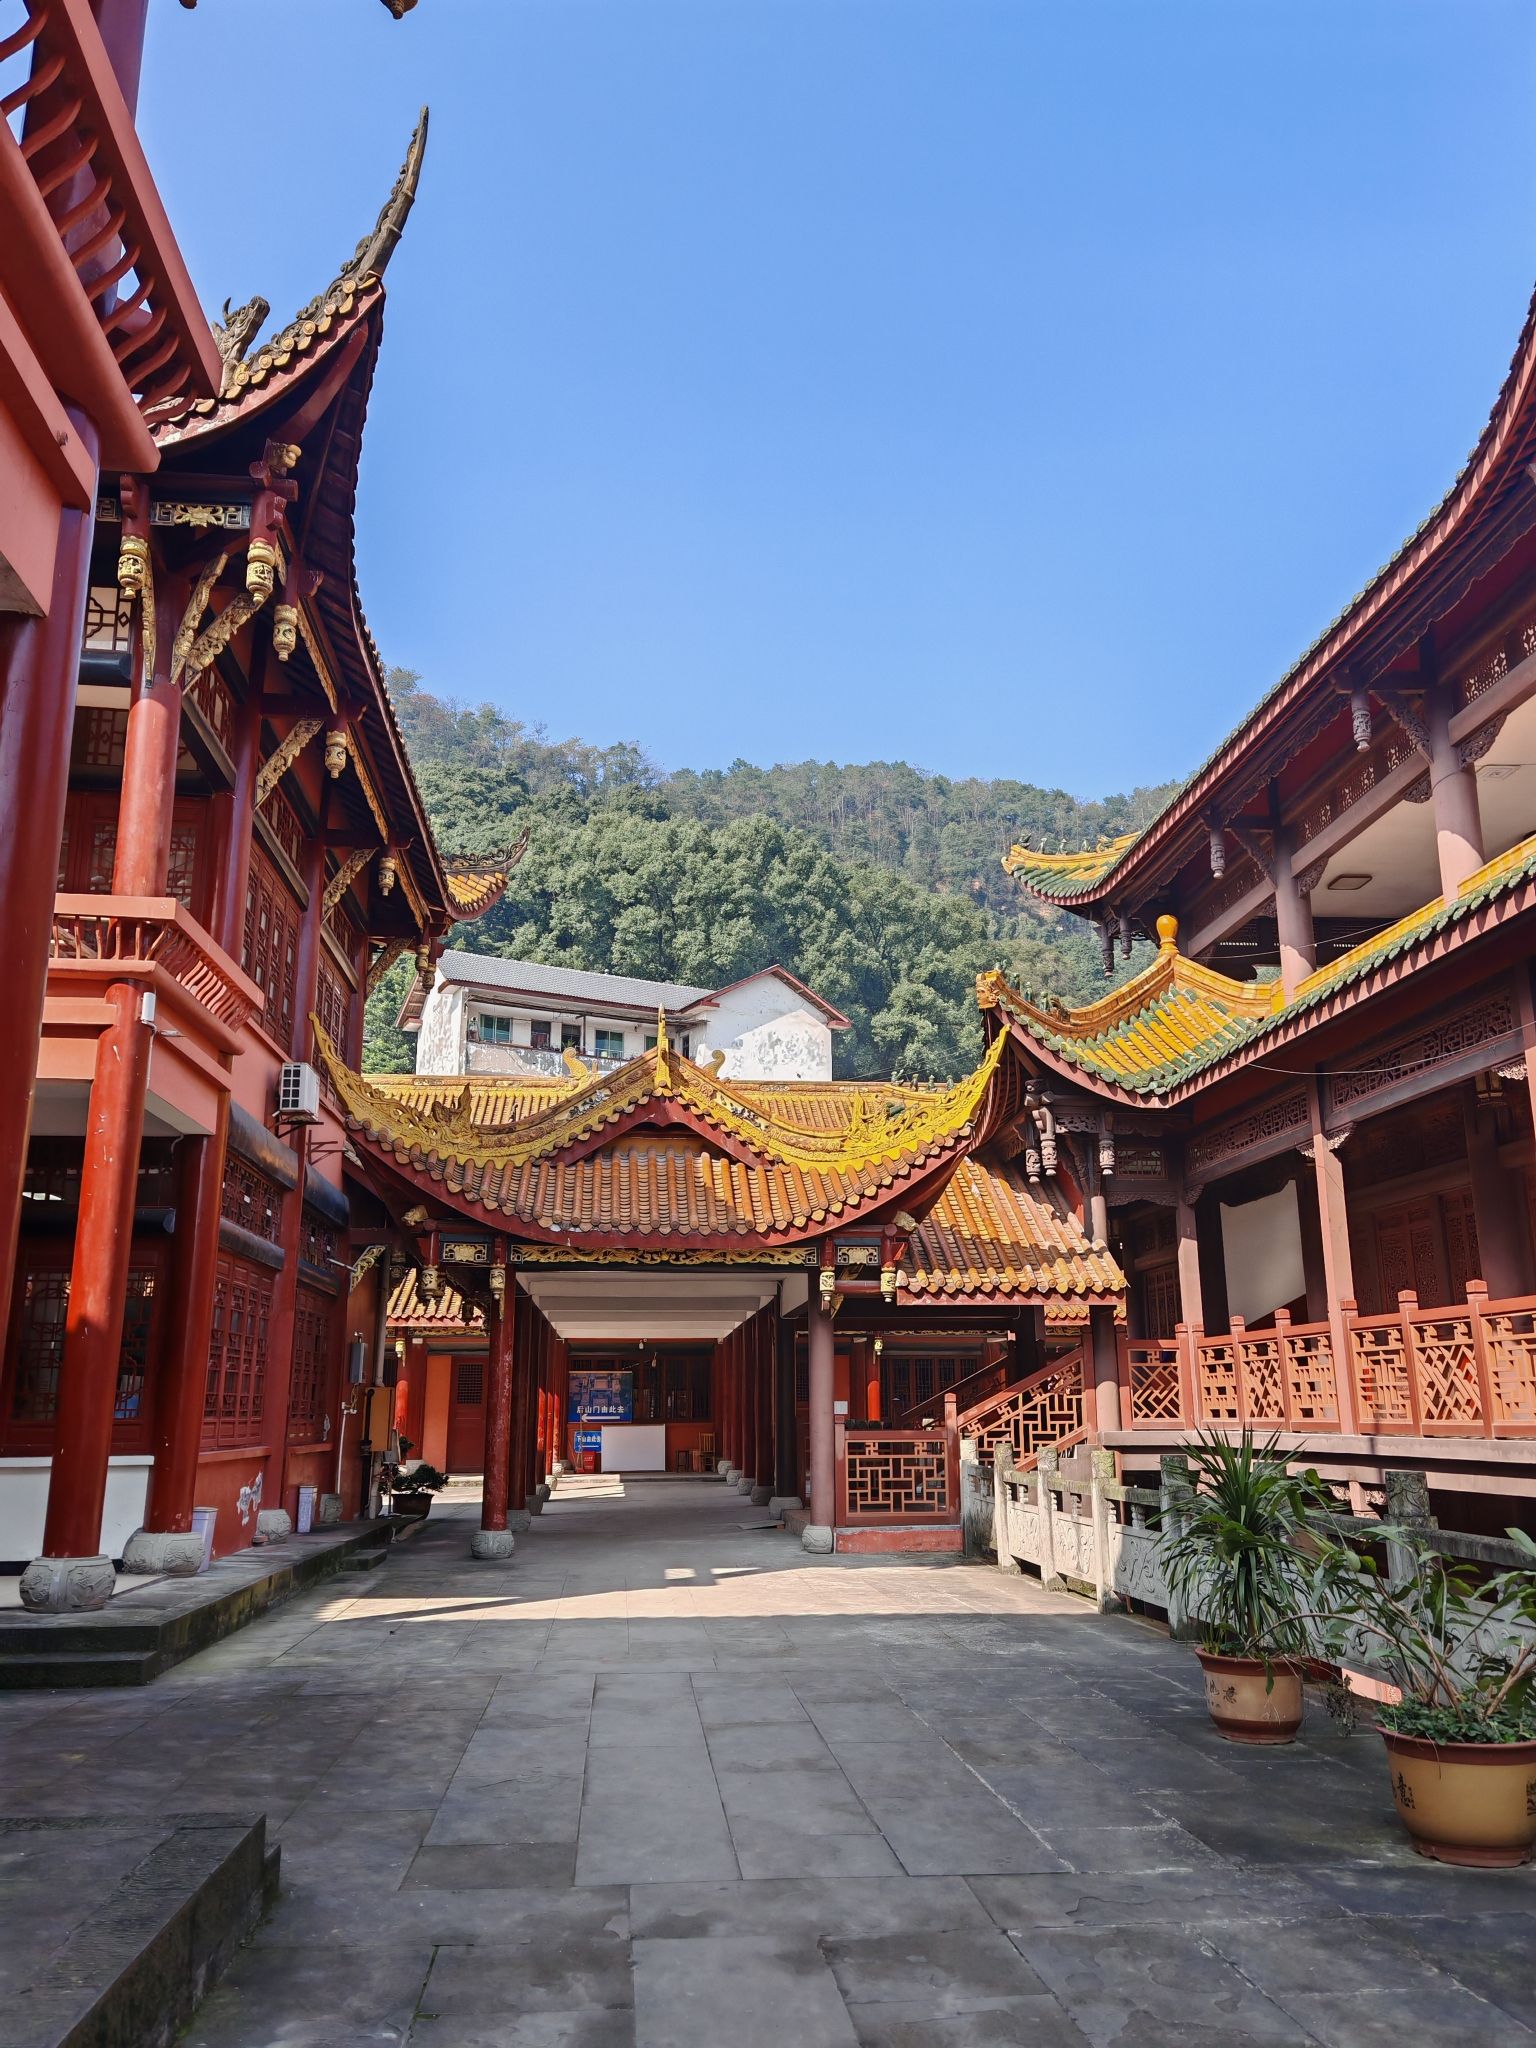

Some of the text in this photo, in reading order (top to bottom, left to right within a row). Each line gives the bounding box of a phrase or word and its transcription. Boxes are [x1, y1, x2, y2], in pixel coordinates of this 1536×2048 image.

[576, 1405, 625, 1414] 后山门由此去
